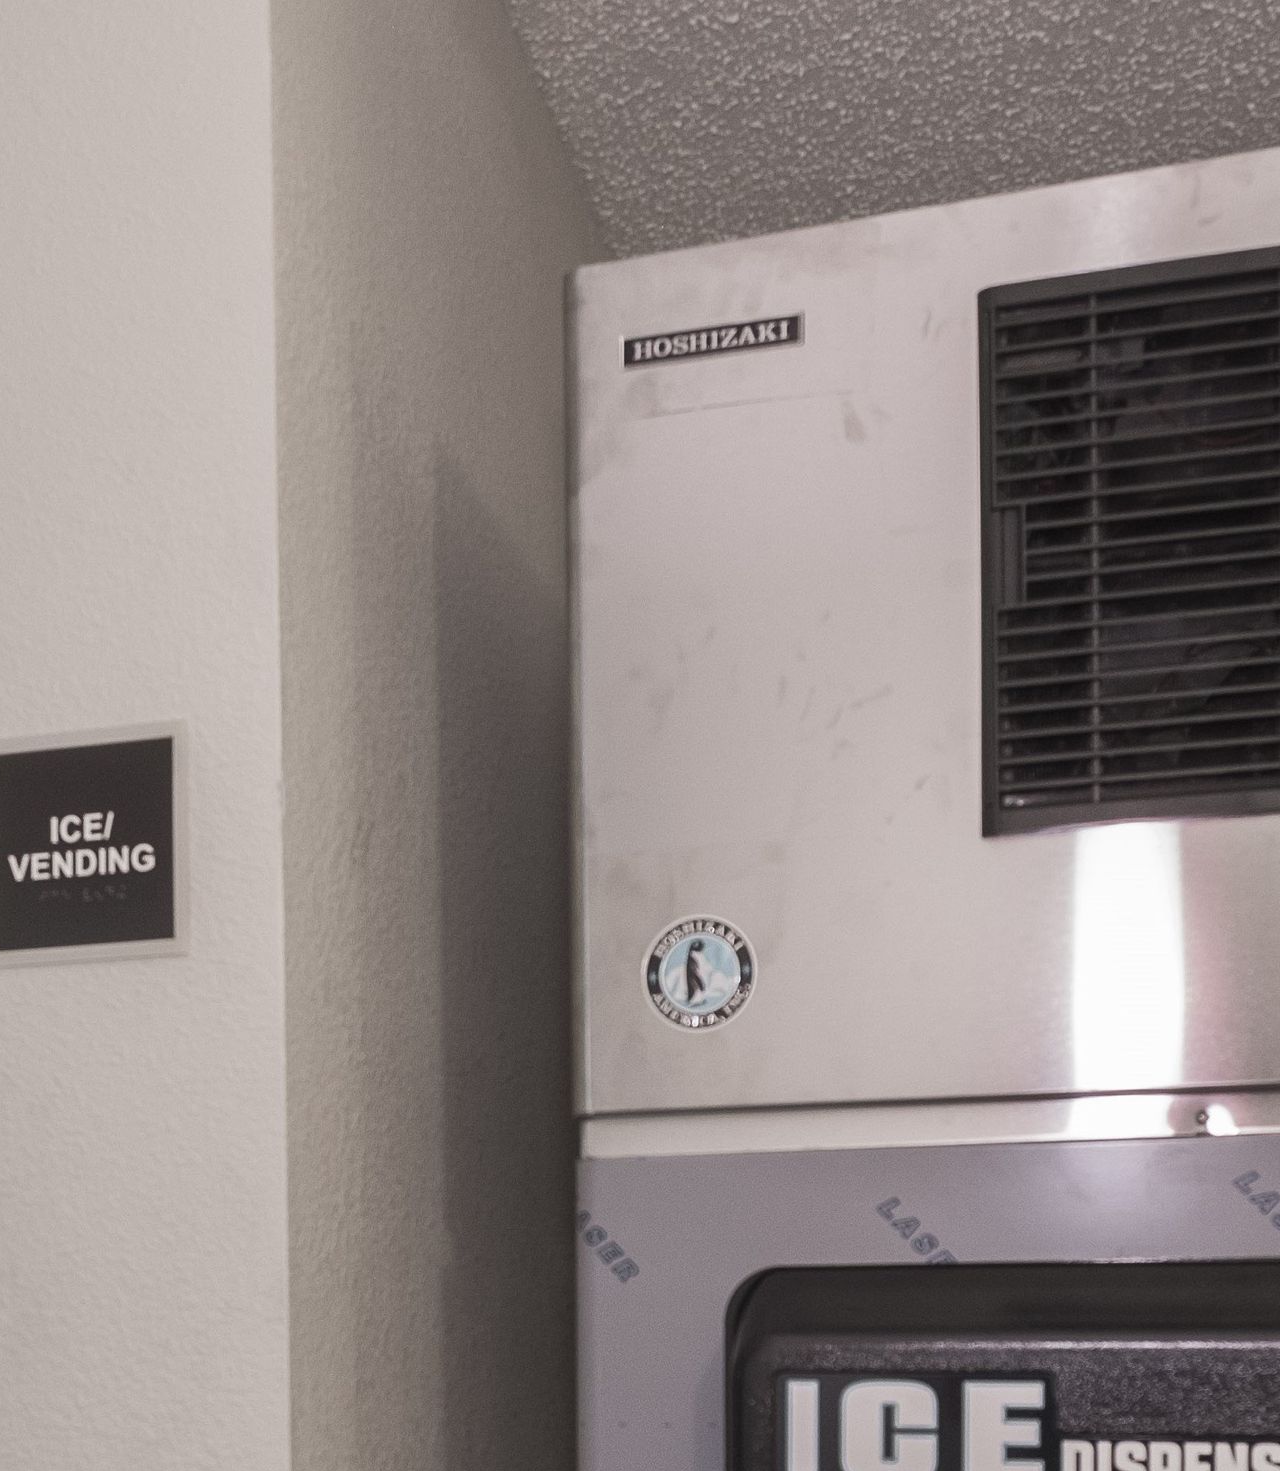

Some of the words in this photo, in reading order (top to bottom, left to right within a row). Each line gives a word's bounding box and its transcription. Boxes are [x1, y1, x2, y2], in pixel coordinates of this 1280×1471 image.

[633, 319, 790, 362] HOSHIZAKI
[49, 810, 115, 845] ICE/
[7, 843, 156, 882] VENDING
